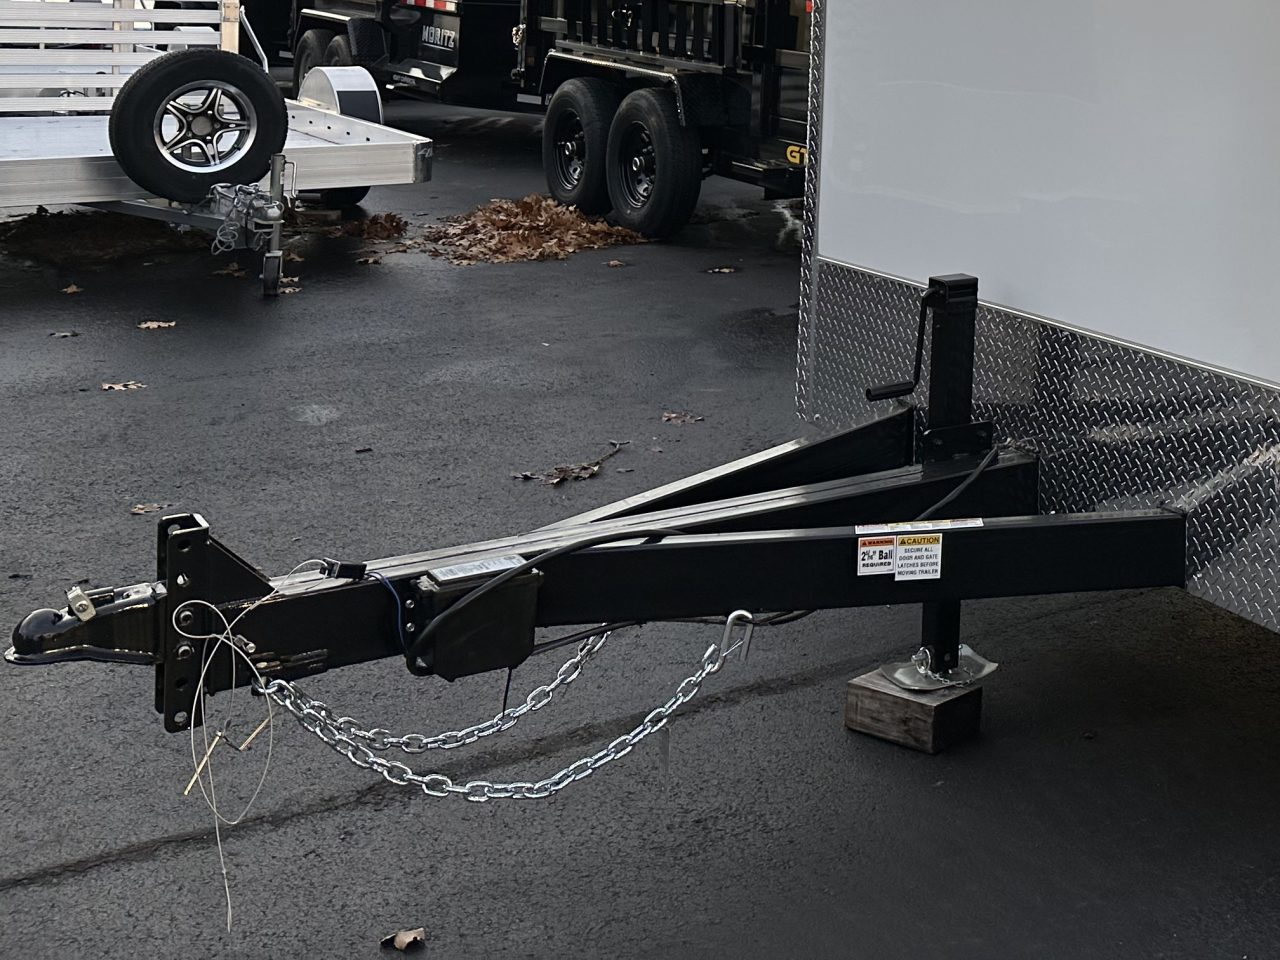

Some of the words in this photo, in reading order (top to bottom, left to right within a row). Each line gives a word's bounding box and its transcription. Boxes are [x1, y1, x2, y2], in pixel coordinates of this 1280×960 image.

[421, 25, 456, 48] MORITZ
[906, 537, 940, 545] CAUTION
[878, 549, 893, 560] Ball
